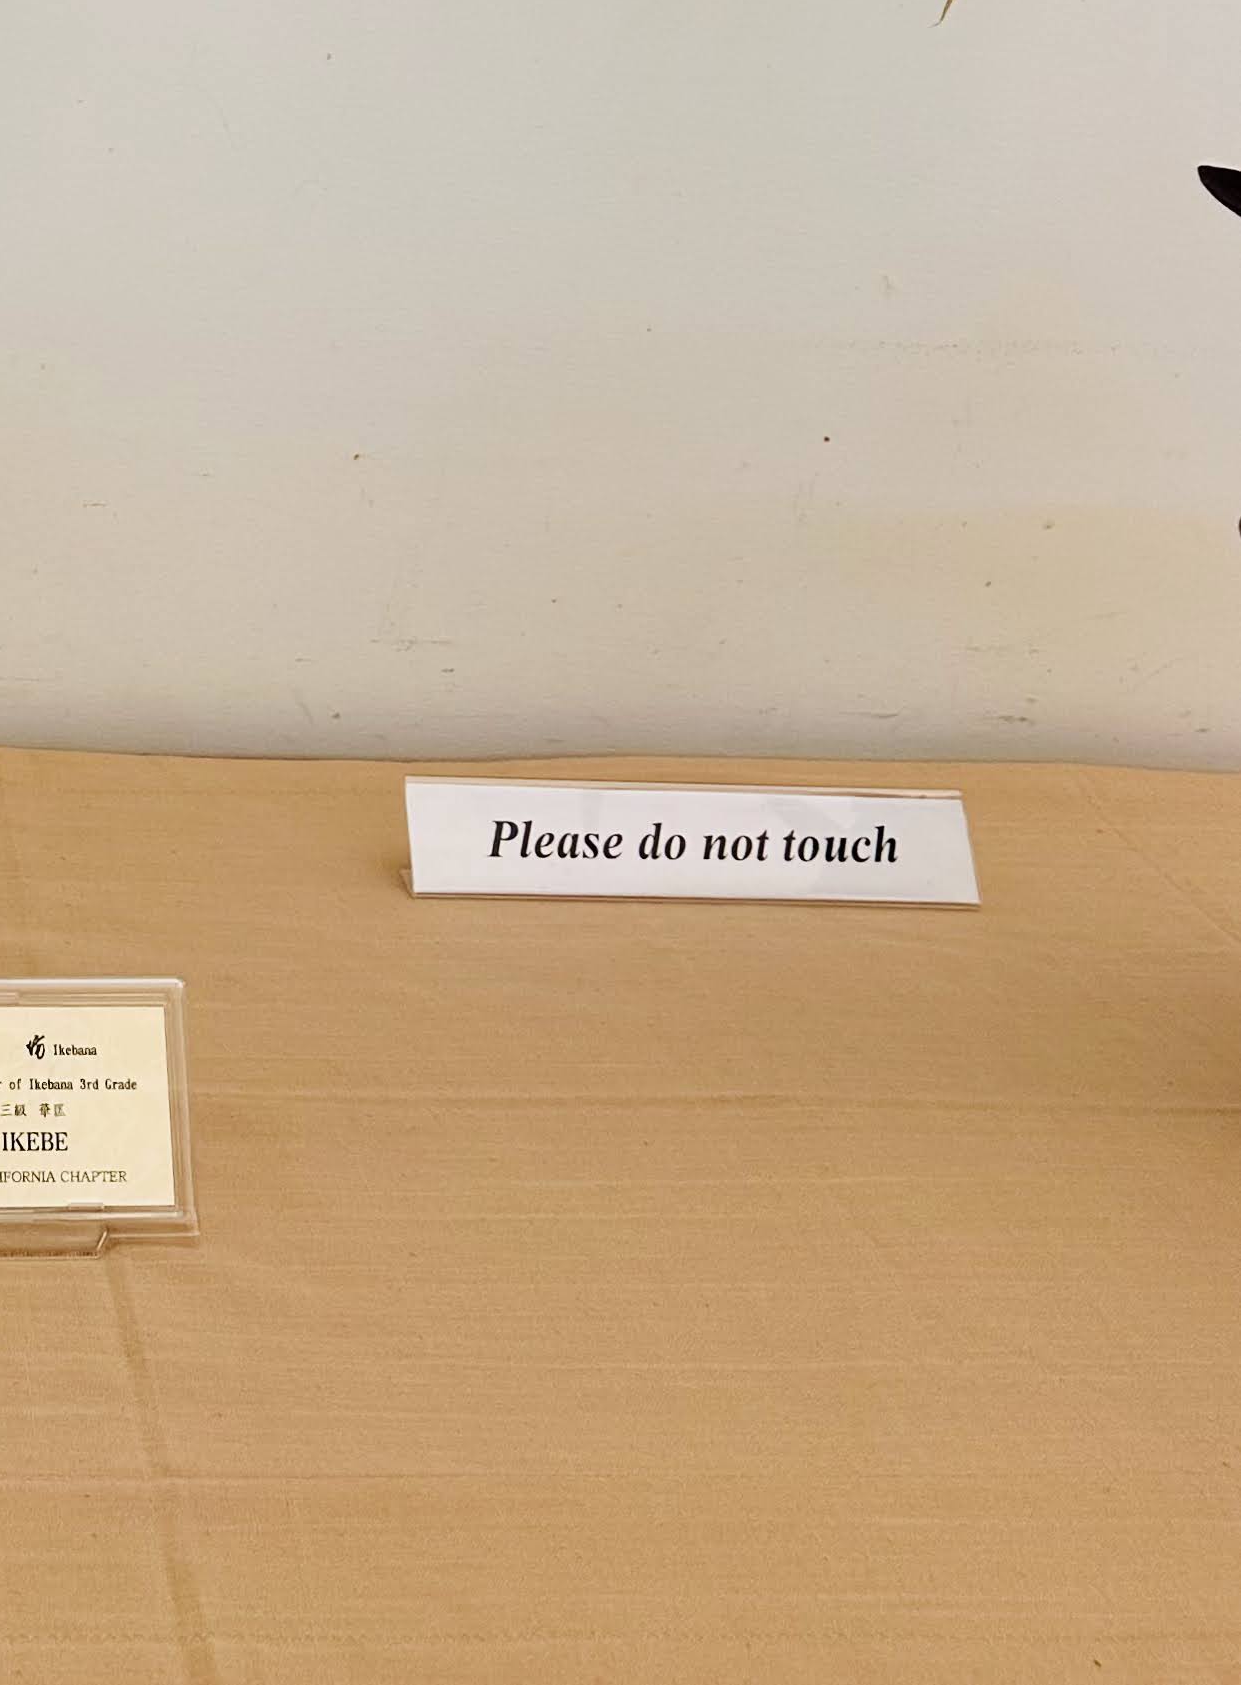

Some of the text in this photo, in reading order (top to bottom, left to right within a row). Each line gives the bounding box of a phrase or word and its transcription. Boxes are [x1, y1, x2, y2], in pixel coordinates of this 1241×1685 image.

[489, 820, 897, 863] Please do not touch
[54, 1044, 97, 1055] Ikebana
[9, 1079, 21, 1090] of
[30, 1079, 73, 1090] Ikebana
[80, 1079, 98, 1090] 3rd
[105, 1079, 136, 1089] Grade
[3, 1132, 68, 1151] IKEBE
[61, 1171, 126, 1182] CHAPTER
